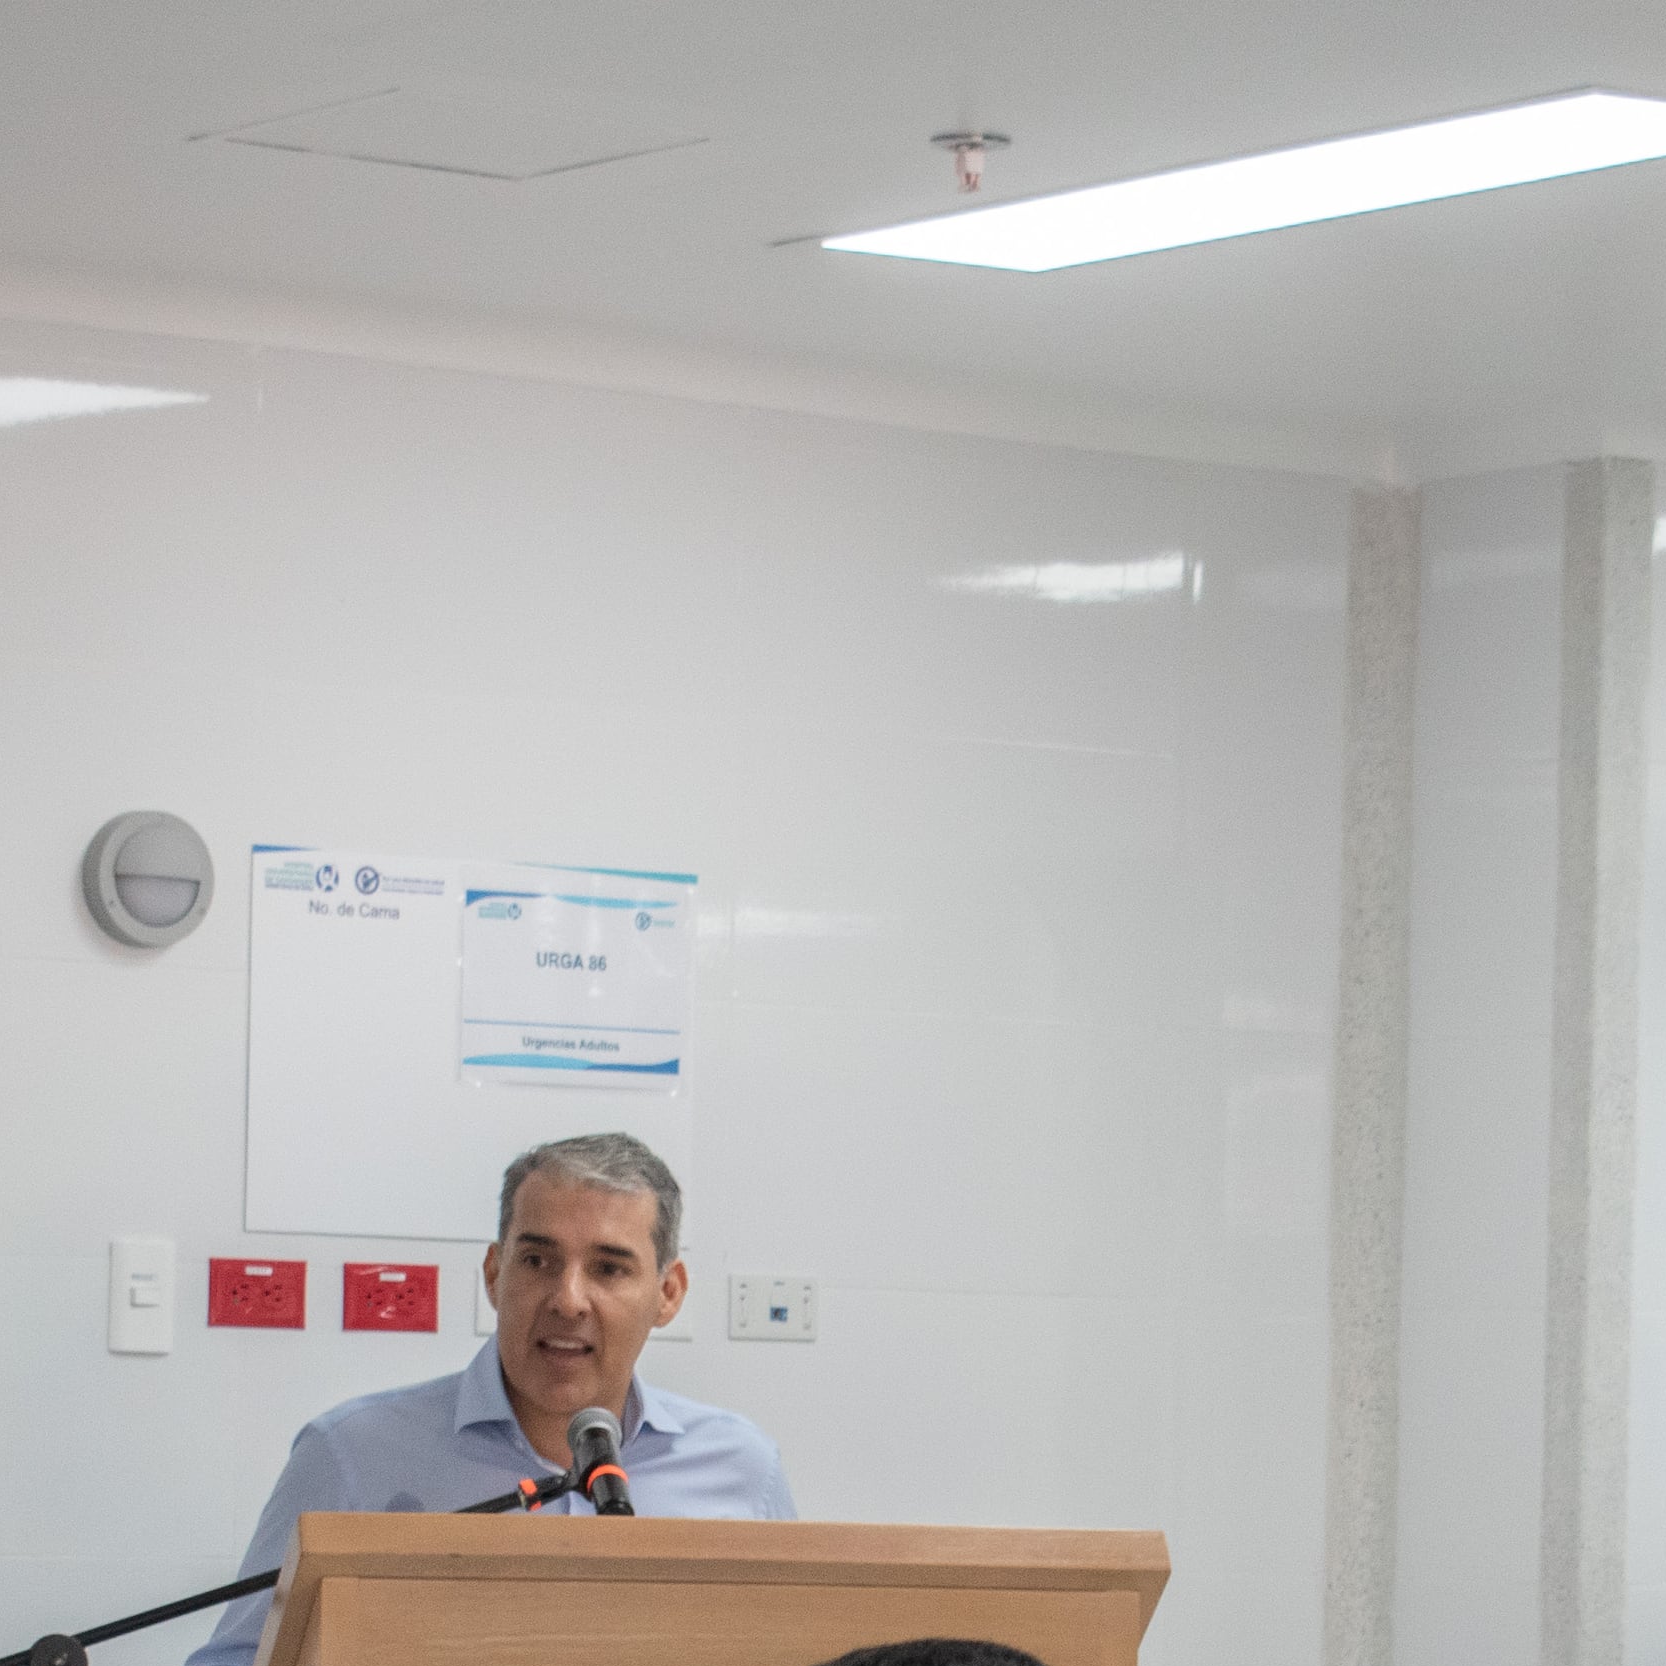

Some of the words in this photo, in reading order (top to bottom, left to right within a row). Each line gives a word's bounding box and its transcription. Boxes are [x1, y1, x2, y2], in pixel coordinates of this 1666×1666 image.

[337, 901, 355, 917] de
[359, 903, 400, 920] Cama
[536, 952, 583, 971] URGA
[522, 1036, 576, 1052] Urgencias
